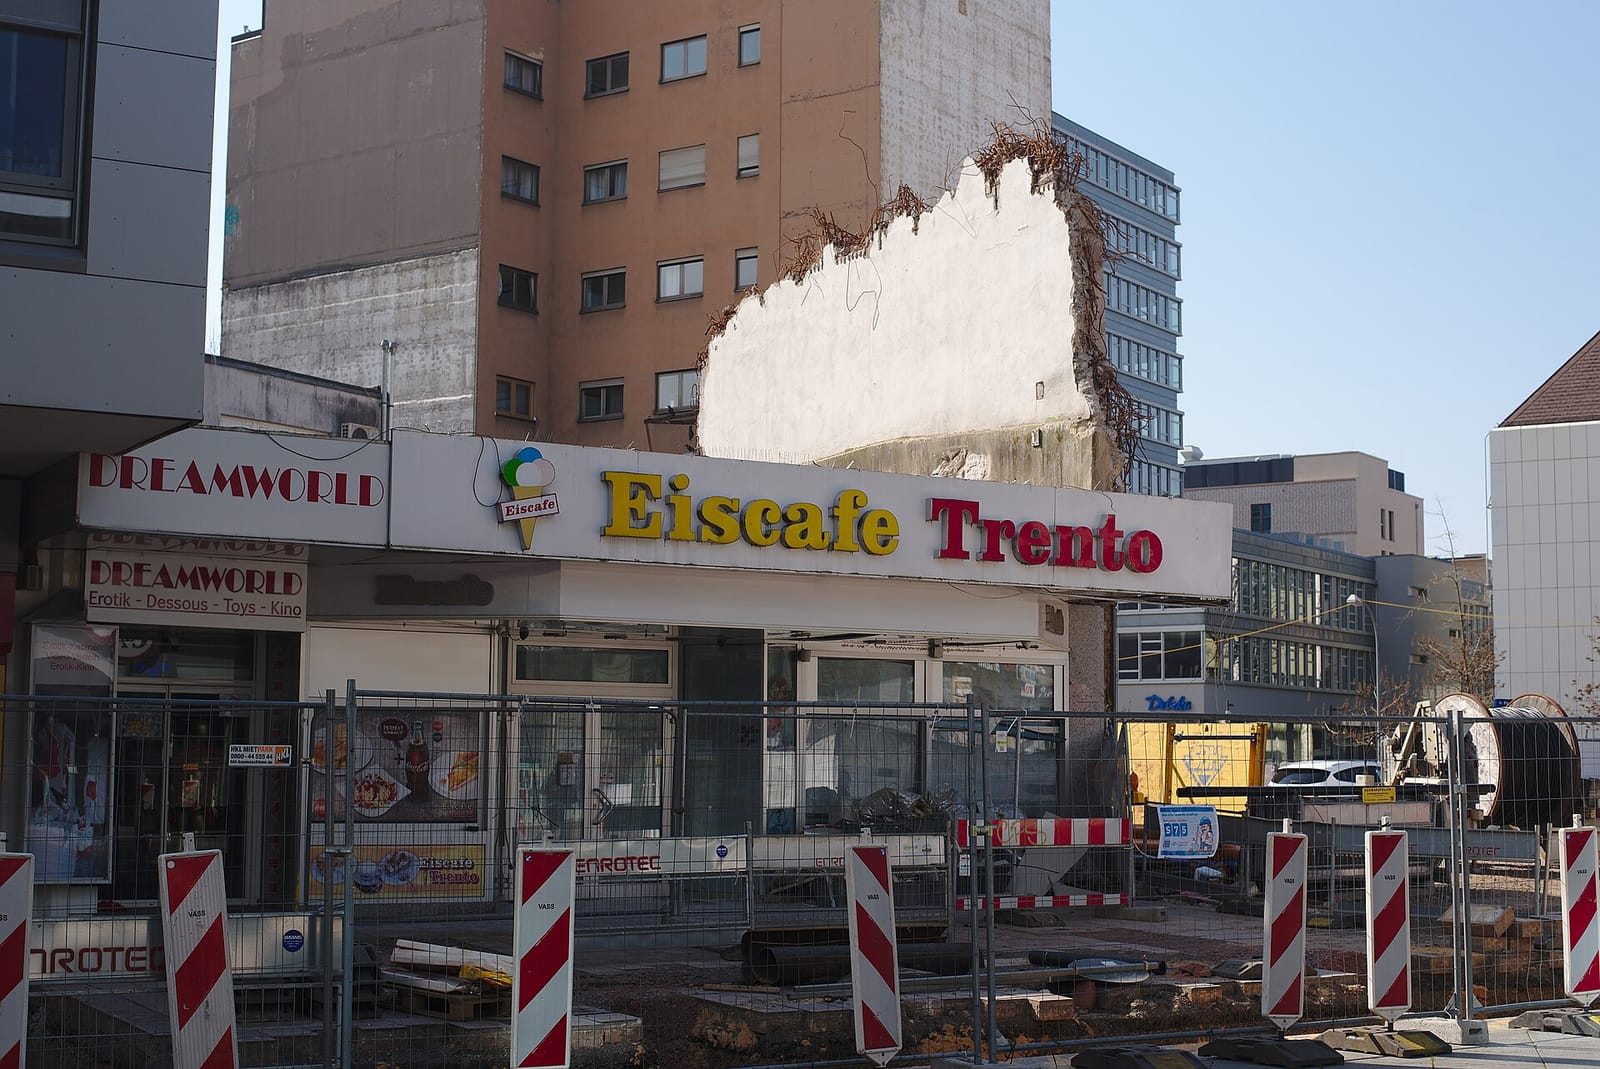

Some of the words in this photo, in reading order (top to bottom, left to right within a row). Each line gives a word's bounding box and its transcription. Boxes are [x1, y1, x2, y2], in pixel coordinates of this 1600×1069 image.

[88, 453, 385, 508] DREAMWORLD
[504, 499, 555, 517] Eiscafe
[600, 470, 900, 556] Eiscafe
[925, 497, 1164, 574] Trento
[90, 559, 303, 596] DREAMWORLD
[89, 590, 130, 607] Erotik
[146, 593, 208, 611] Dessous
[223, 598, 256, 617] Toys
[271, 600, 302, 616] Kino
[50, 662, 95, 671] Erotik-Kino
[419, 856, 475, 870] Eiscafe
[430, 870, 480, 884] Trento
[188, 909, 206, 918] VASS
